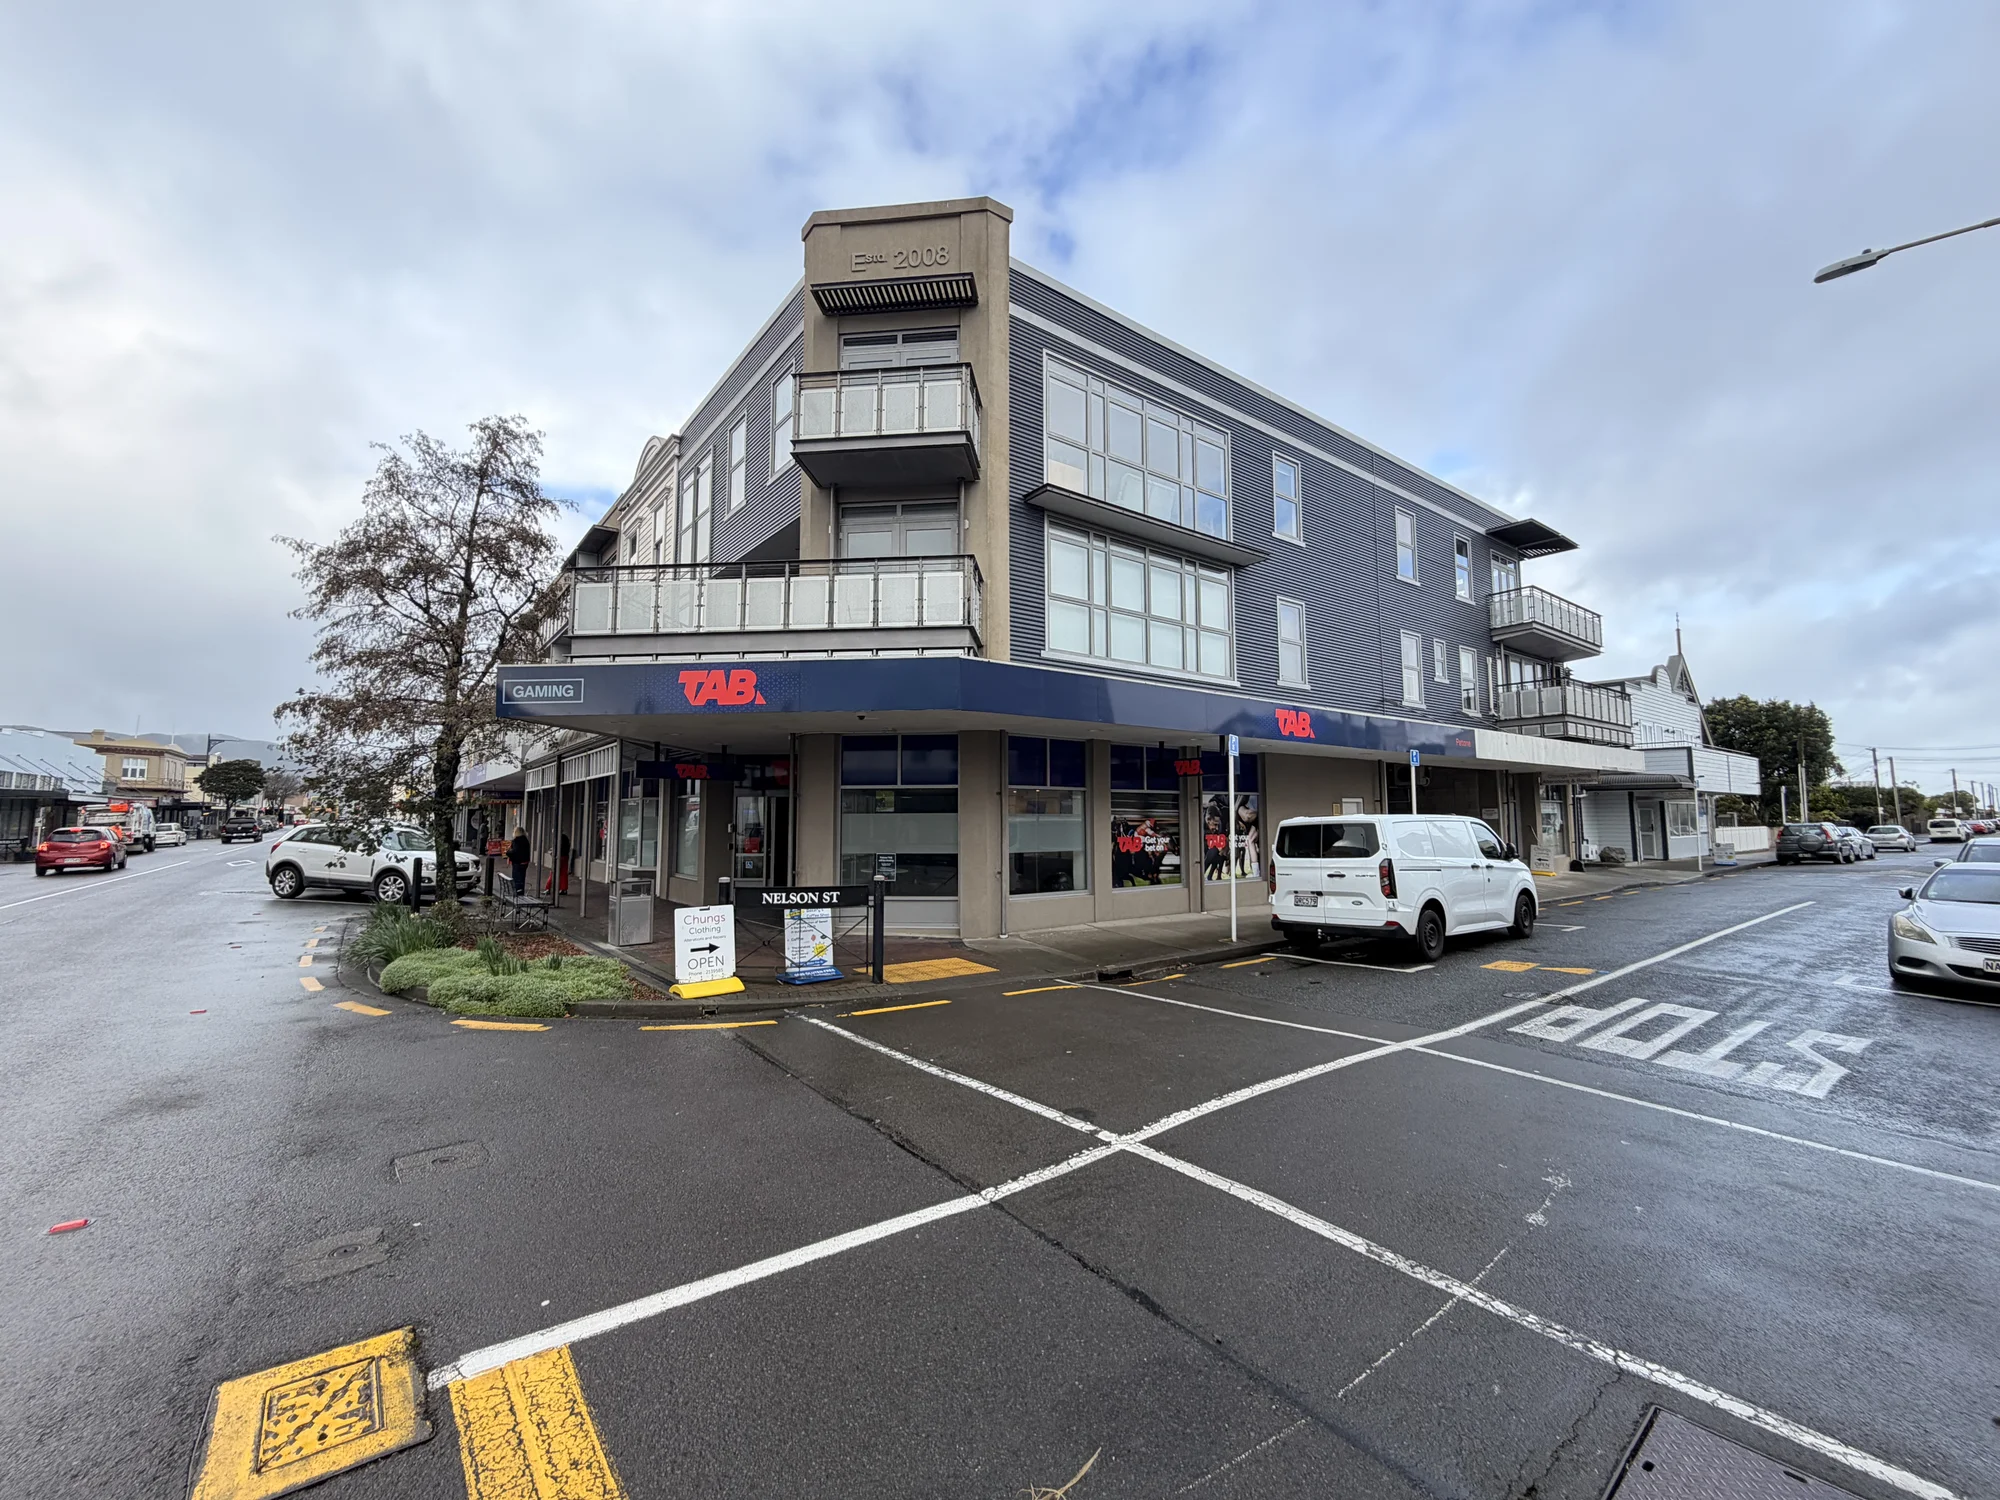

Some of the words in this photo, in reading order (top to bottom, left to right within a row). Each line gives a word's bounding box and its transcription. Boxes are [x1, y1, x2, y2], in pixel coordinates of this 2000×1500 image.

[893, 246, 950, 270] 2008
[512, 685, 575, 698] GAMING
[1117, 836, 1143, 853] TAB
[1145, 836, 1156, 844] Get
[1156, 837, 1170, 845] your
[1145, 843, 1156, 851] bet
[762, 892, 820, 905] NELSON
[822, 891, 840, 903] ST
[683, 914, 726, 926] Chungs
[688, 925, 721, 935] Clothing
[687, 955, 725, 970] OPEN
[1506, 998, 1876, 1099] STOP
